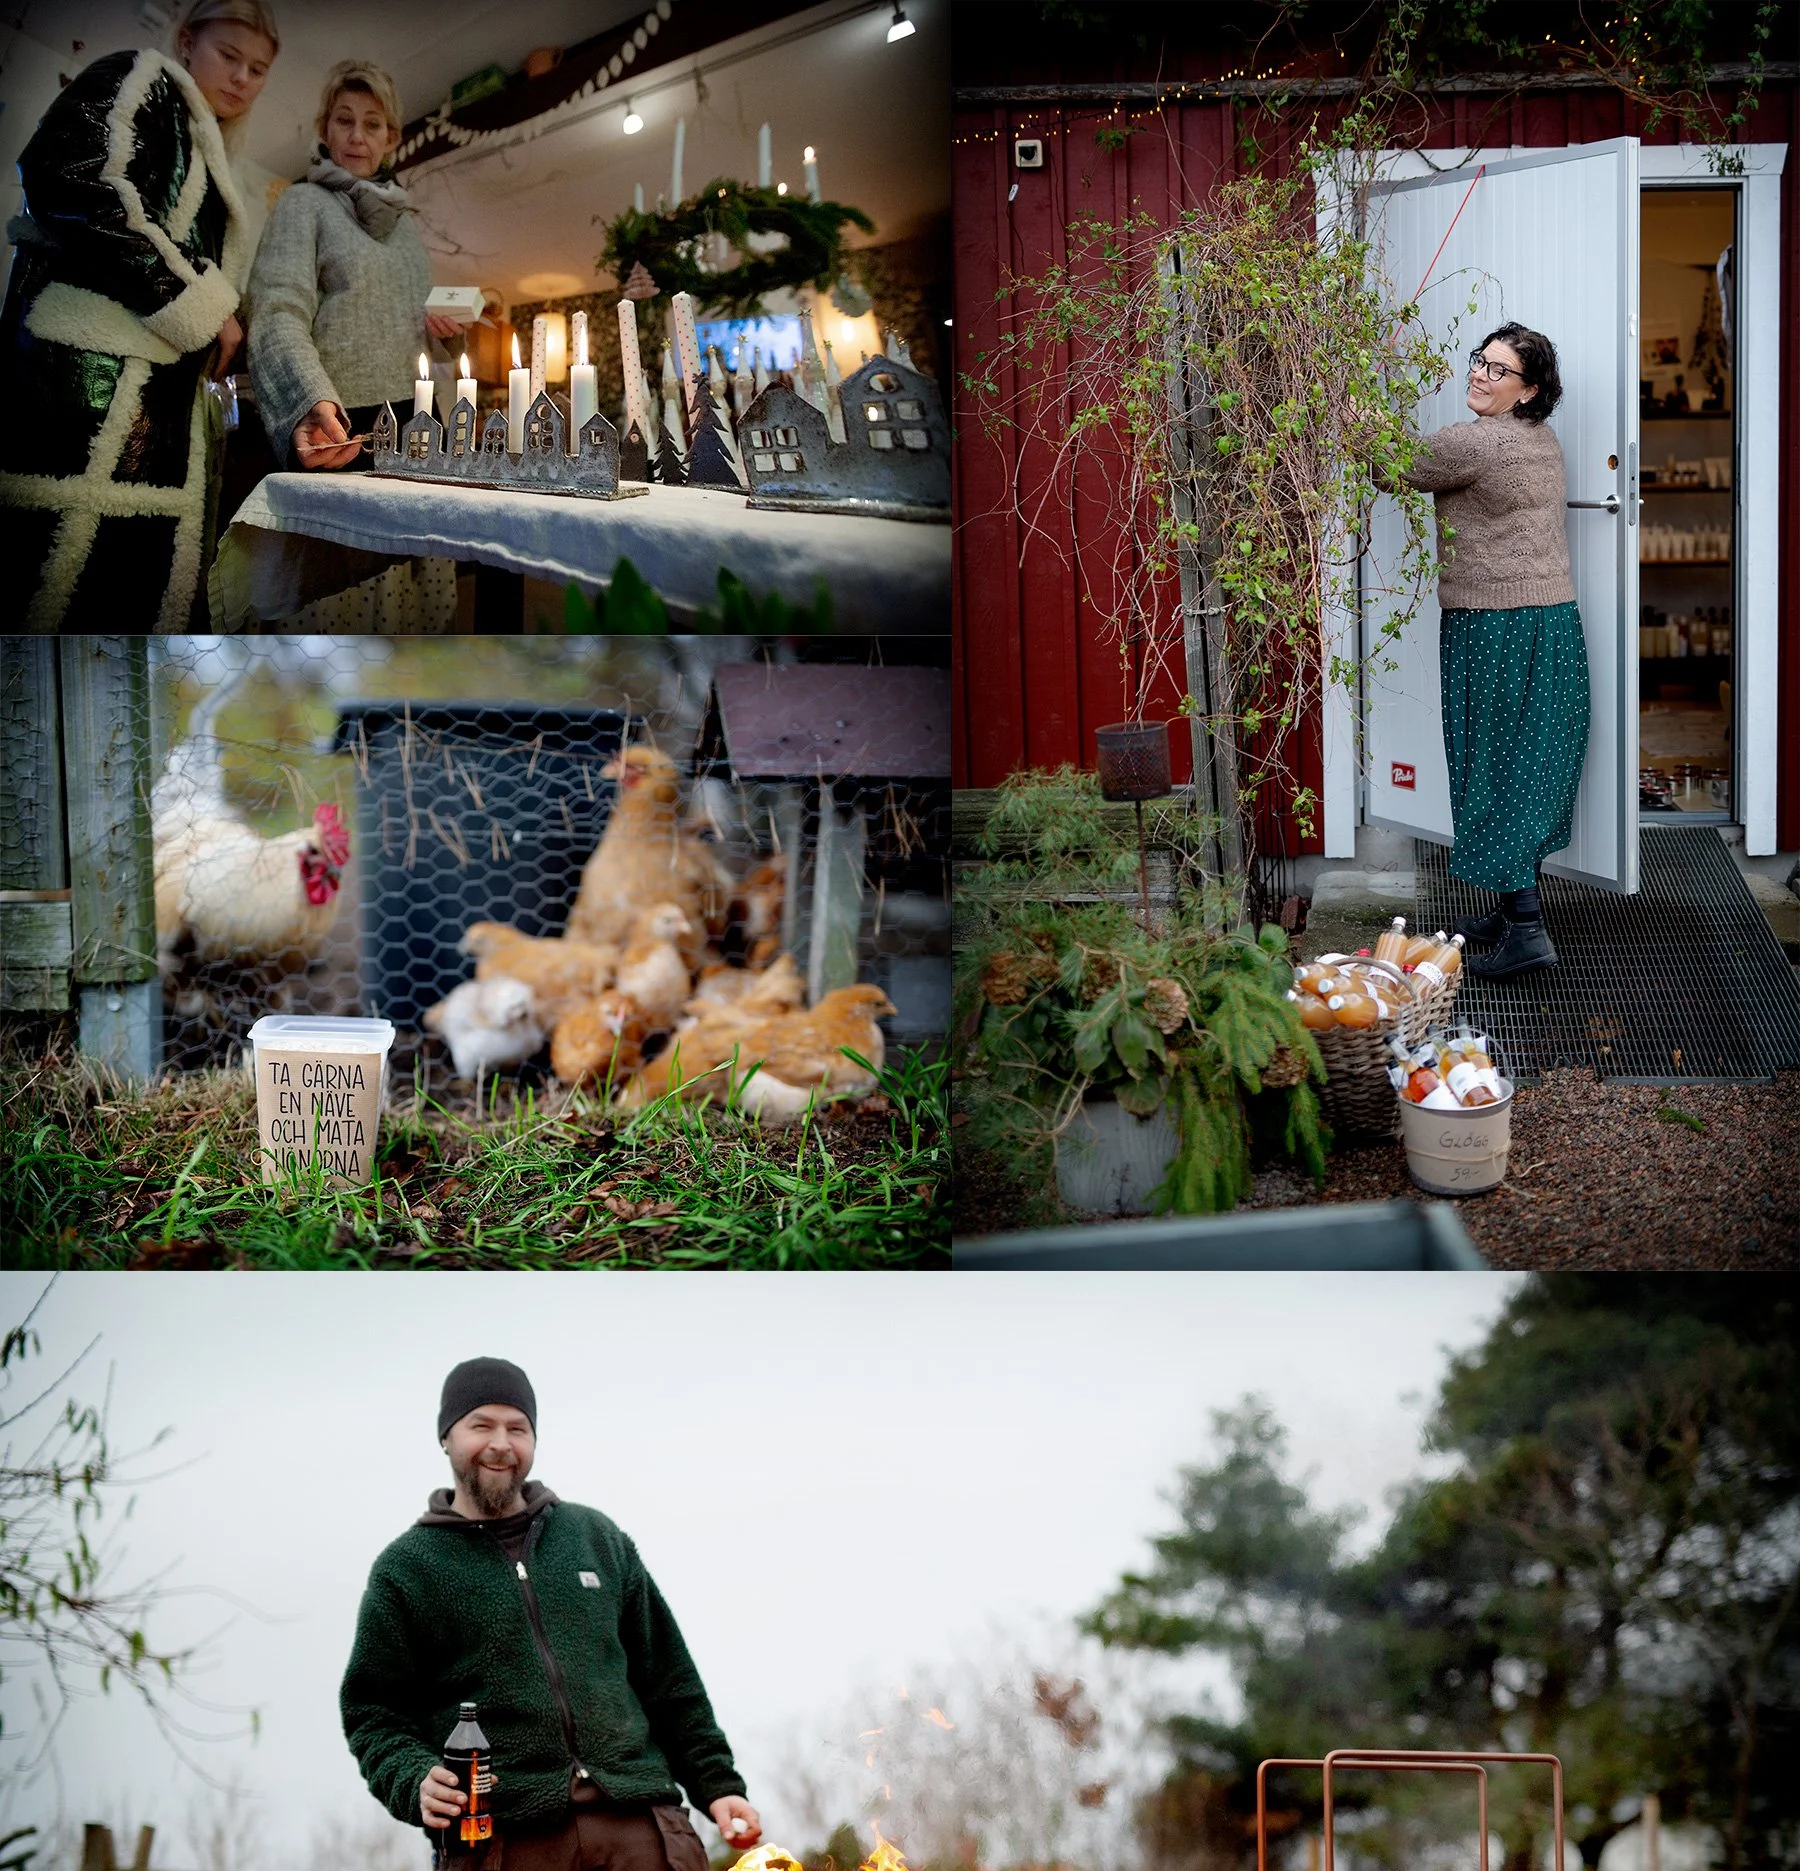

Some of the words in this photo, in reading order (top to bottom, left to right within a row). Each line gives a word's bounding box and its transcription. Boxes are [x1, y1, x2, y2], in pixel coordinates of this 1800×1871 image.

[268, 1061, 291, 1087] TA
[302, 1060, 365, 1090] GÄRNA
[279, 1092, 301, 1115] EN
[311, 1090, 356, 1118] NÄVE
[271, 1119, 306, 1144] OCH
[318, 1119, 365, 1146] MATA
